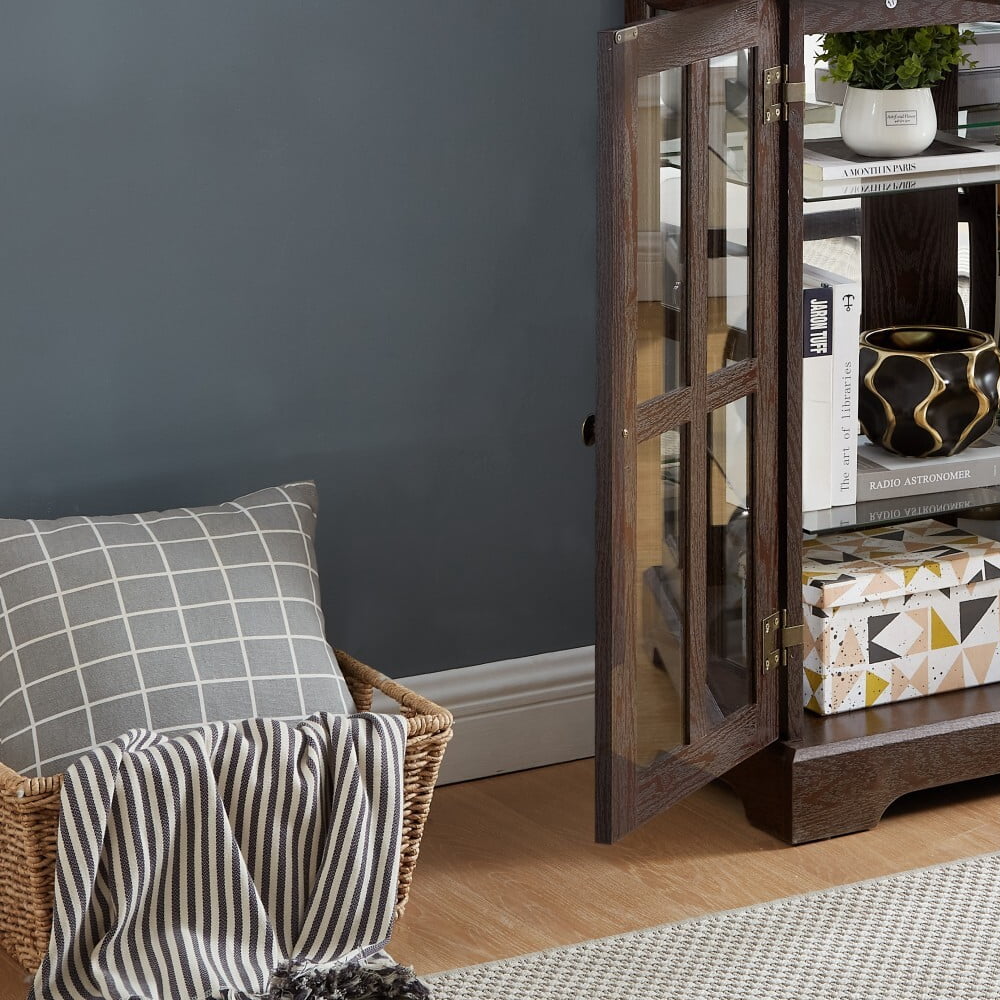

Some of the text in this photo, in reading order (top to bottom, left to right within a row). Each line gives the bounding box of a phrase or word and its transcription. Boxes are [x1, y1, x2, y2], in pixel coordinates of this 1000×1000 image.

[841, 162, 917, 177] A MONTH IN PARIS
[810, 298, 828, 330] JARON
[809, 330, 828, 354] TUFF
[841, 361, 852, 419] libraries
[841, 426, 851, 440] of
[840, 472, 850, 492] The
[869, 469, 971, 490] RADIO ASTRONOMER
